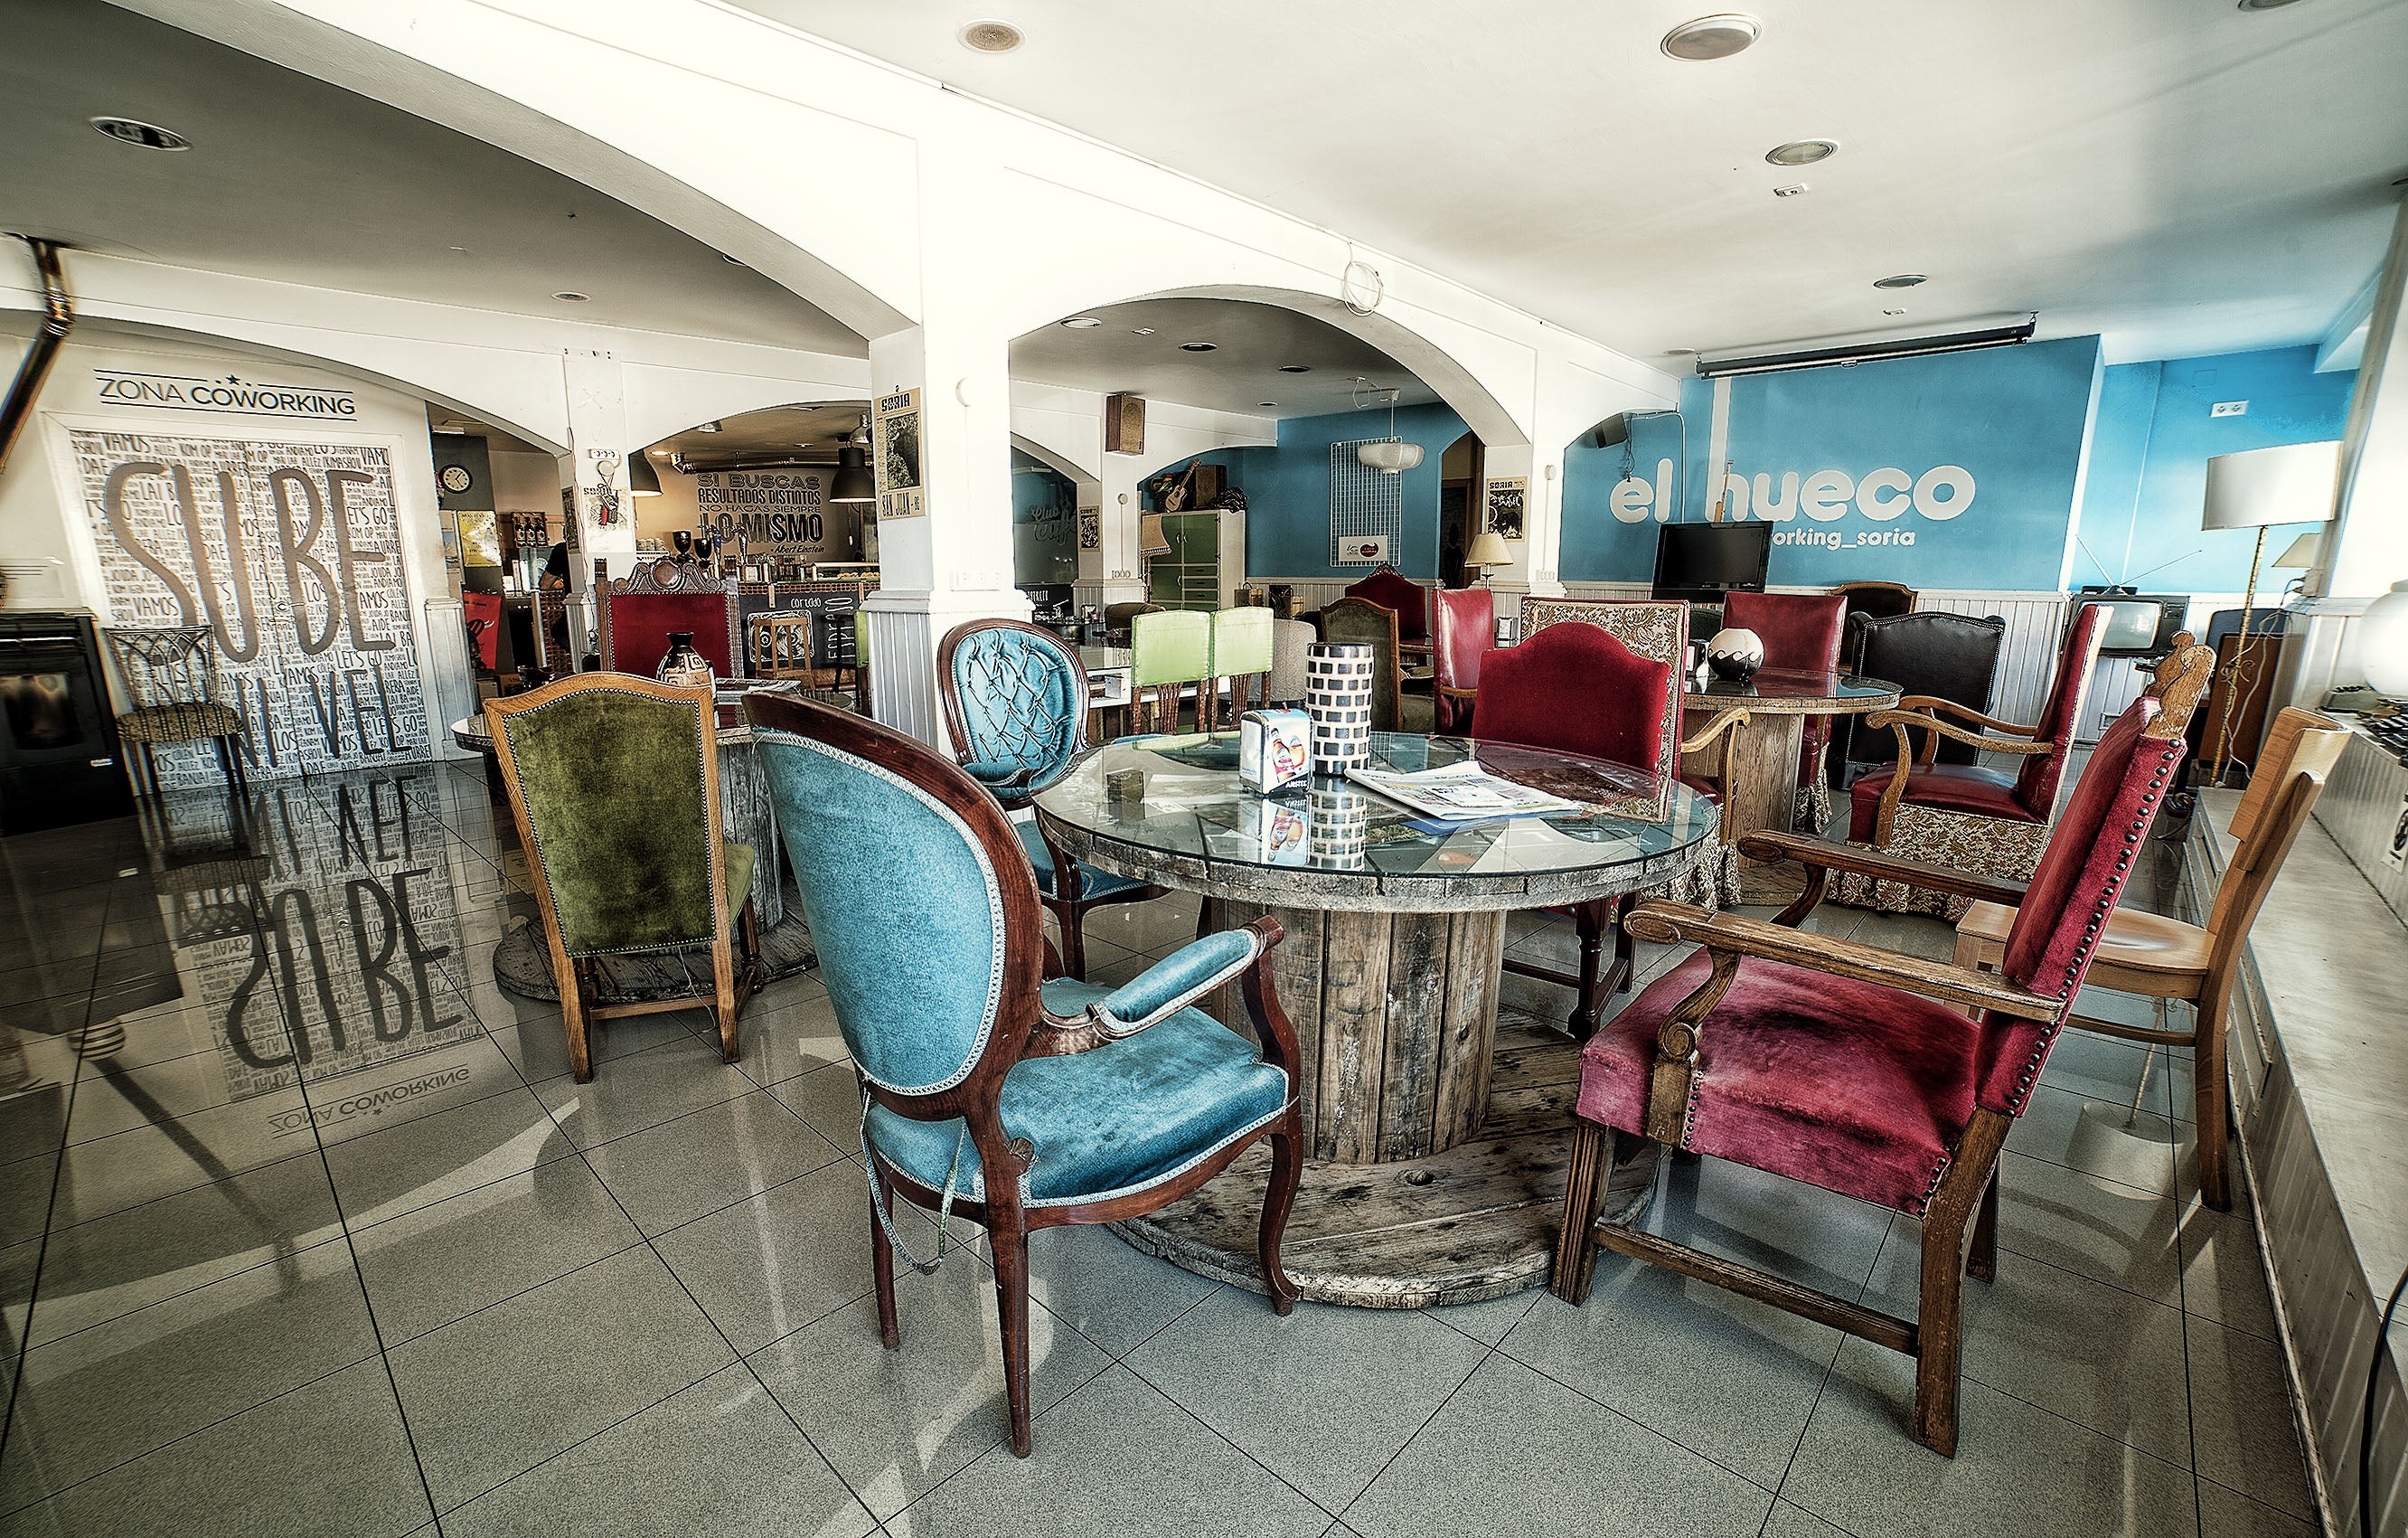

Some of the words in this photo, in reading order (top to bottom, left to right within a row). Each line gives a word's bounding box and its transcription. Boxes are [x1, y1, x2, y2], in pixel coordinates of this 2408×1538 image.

[96, 377, 186, 403] ZONA
[191, 386, 356, 415] COWORKING
[881, 393, 910, 411] SORIA
[697, 473, 720, 487] SI
[729, 474, 821, 489] BUSCAS
[698, 488, 766, 505] RESULTADOS
[768, 490, 821, 505] DISTINTOS
[1610, 458, 1674, 524] el
[347, 506, 371, 524] ET'S
[700, 513, 735, 543] LO
[739, 513, 824, 543] MISMO
[1773, 527, 1916, 551] orking_soria
[775, 544, 796, 554] Albert
[797, 544, 825, 554] Einstein
[133, 597, 180, 617] VAMOS
[359, 590, 389, 609] AMOS
